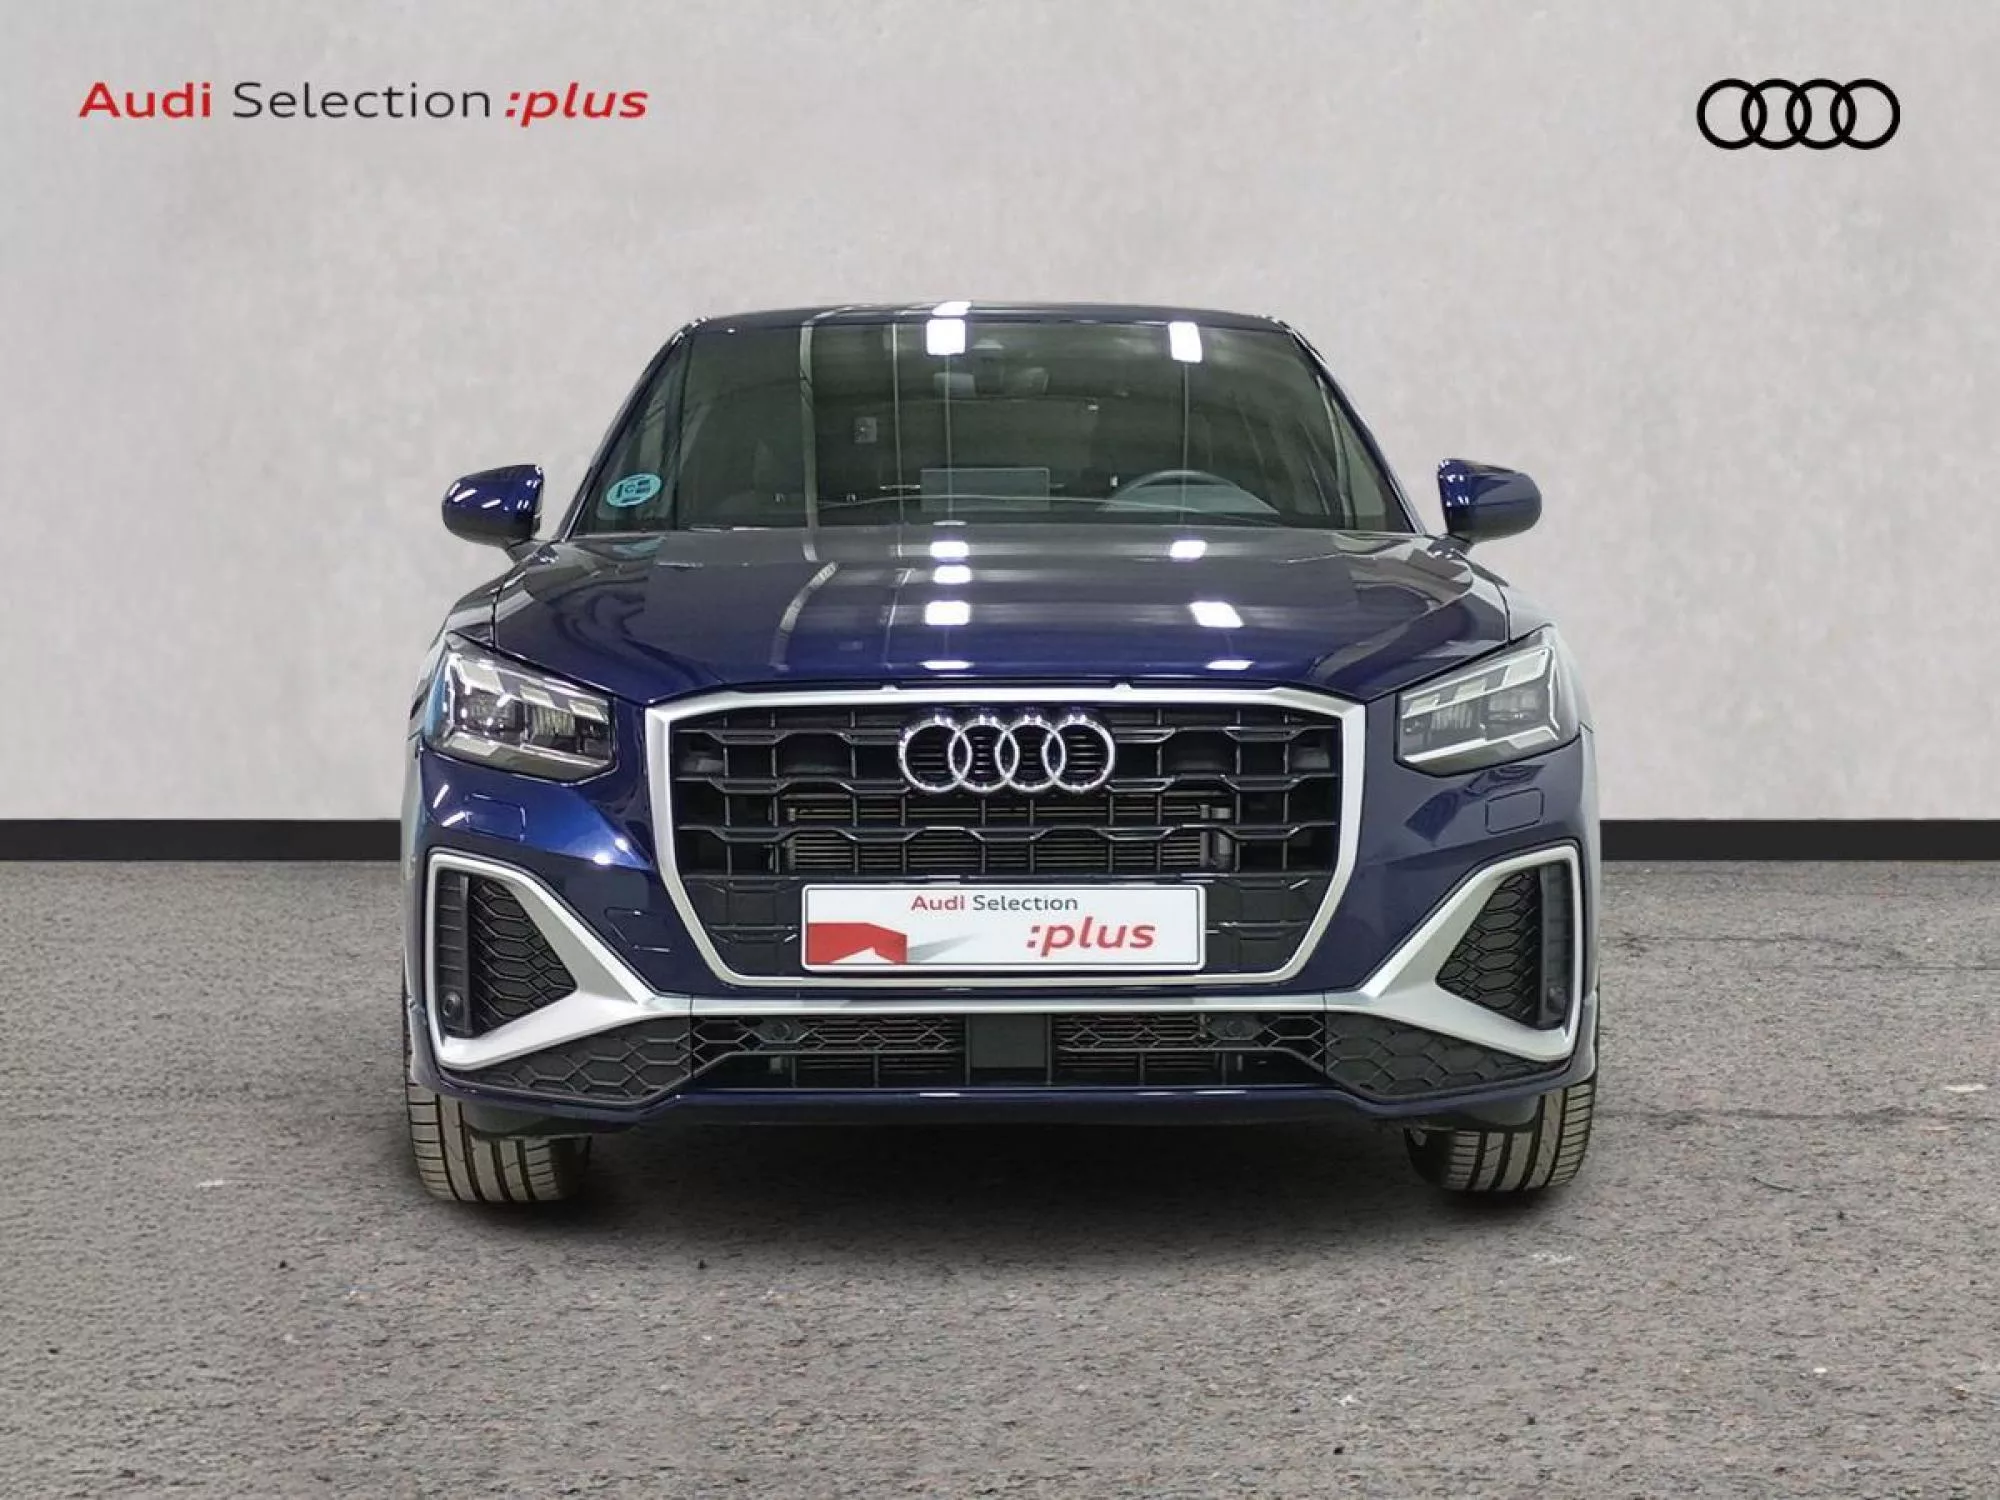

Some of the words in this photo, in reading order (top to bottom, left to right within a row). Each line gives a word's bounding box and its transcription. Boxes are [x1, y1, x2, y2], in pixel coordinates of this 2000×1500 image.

[910, 894, 965, 911] Audi
[972, 894, 1078, 911] Selection
[1026, 916, 1156, 957] :plus
